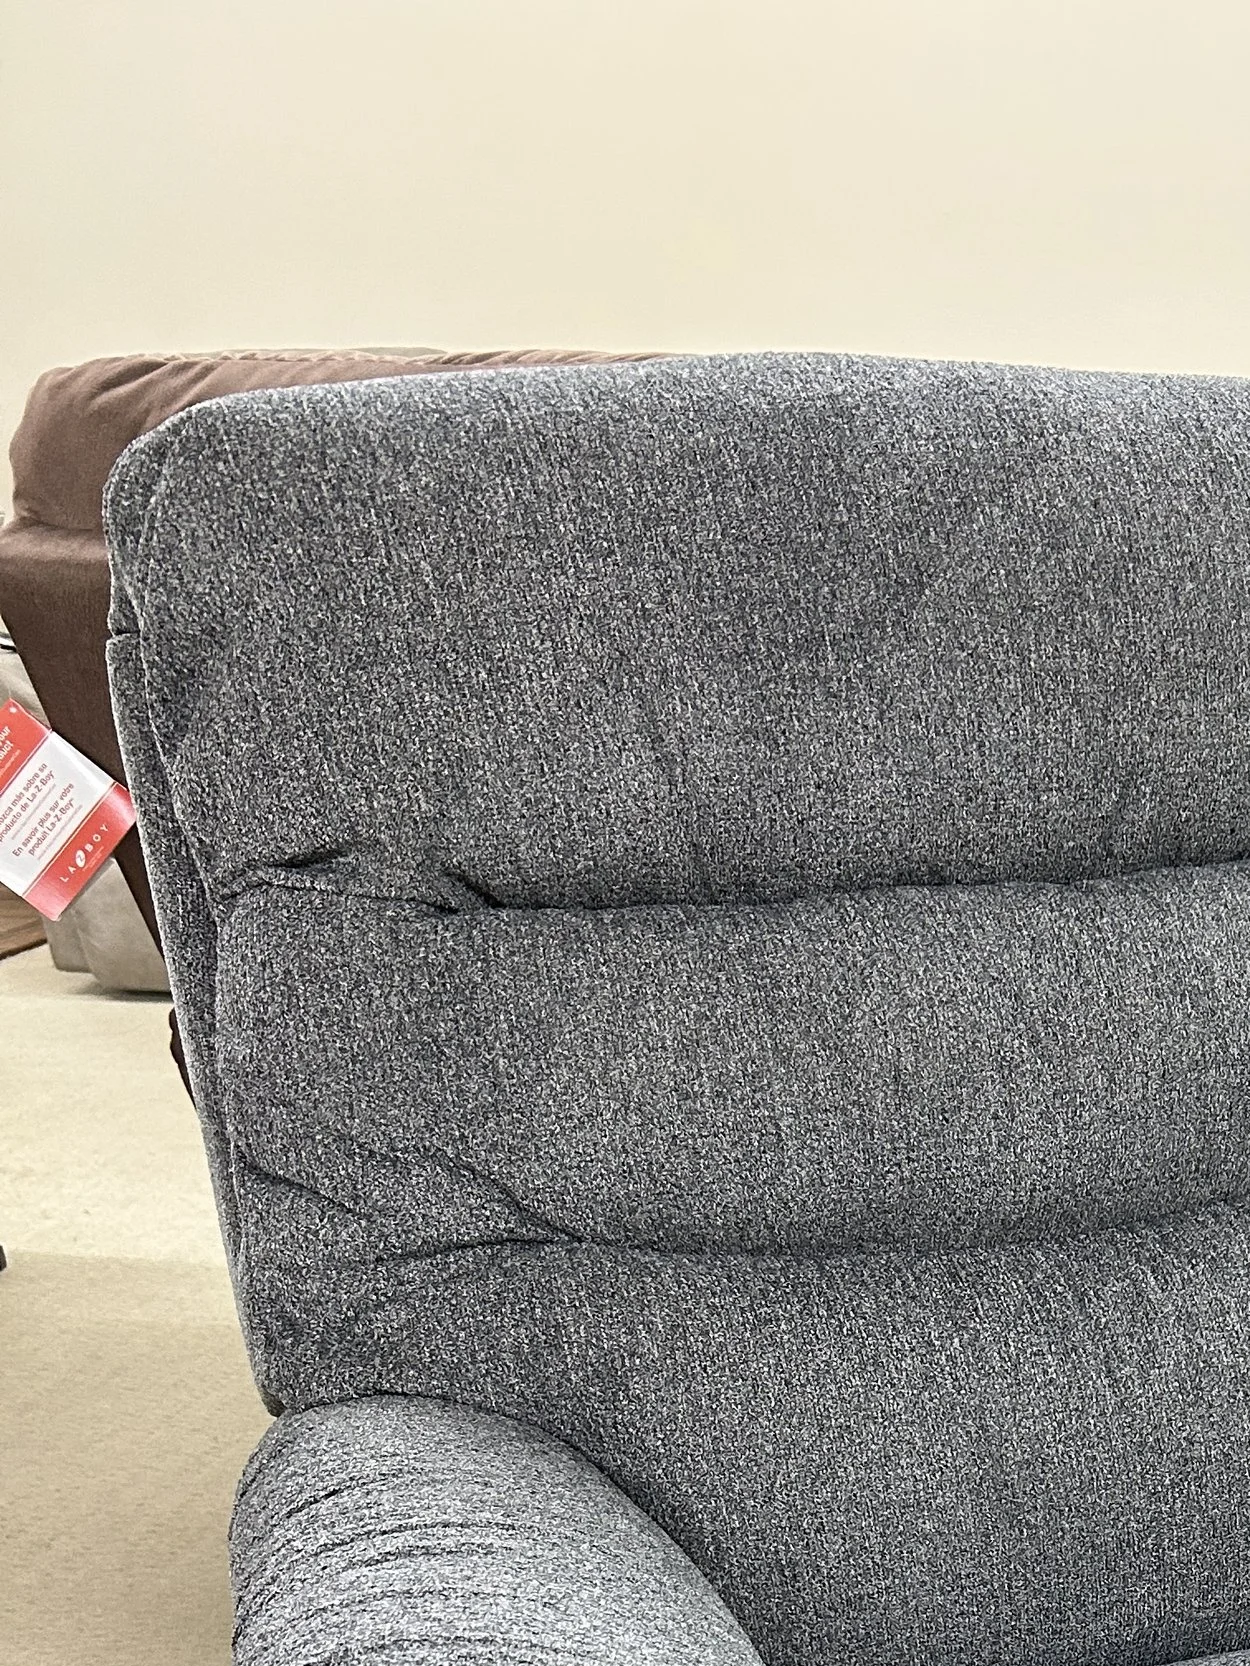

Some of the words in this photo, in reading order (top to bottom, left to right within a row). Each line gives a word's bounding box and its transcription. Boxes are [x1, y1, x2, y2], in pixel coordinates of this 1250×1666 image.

[23, 773, 40, 793] sobre
[20, 801, 30, 814] de
[12, 846, 23, 858] En
[22, 827, 39, 848] savoir
[37, 811, 51, 829] plus
[49, 800, 60, 814] sur
[28, 831, 50, 857] produit
